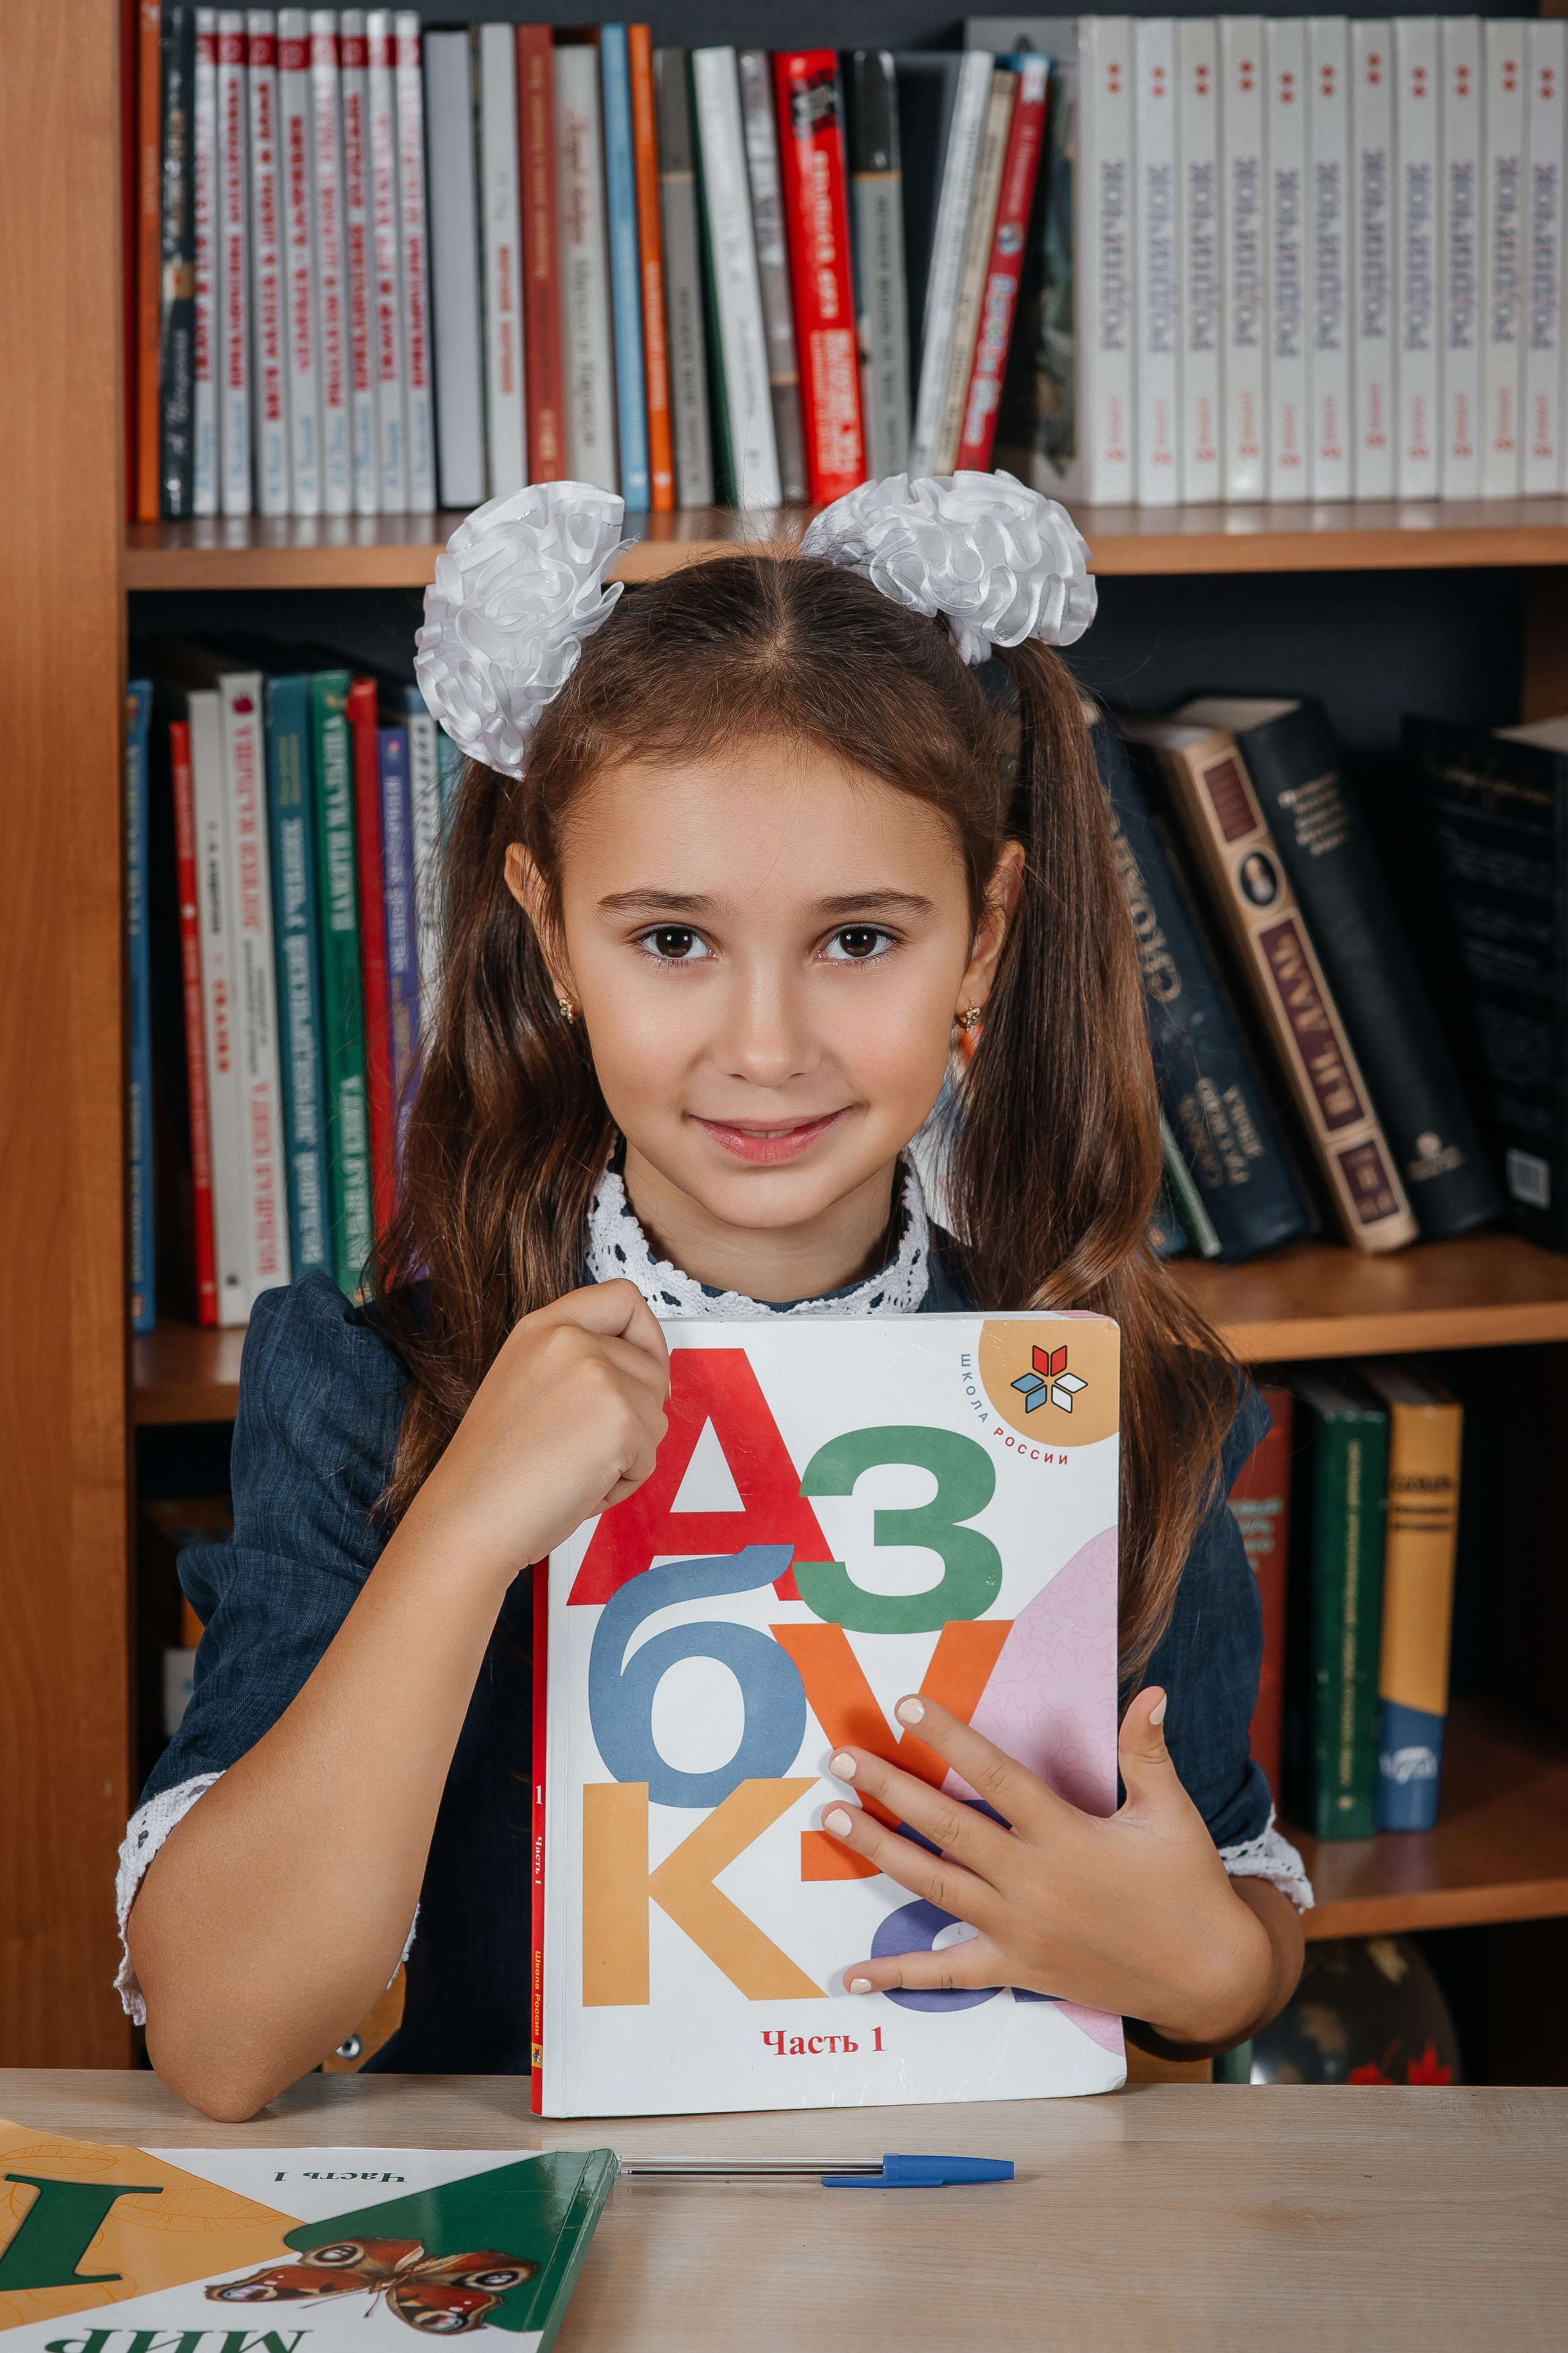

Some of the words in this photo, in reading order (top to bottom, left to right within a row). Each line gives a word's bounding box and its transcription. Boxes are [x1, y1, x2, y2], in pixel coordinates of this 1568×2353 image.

[960, 1353, 989, 1423] ШКОЛА
[993, 1427, 1068, 1465] РОССИИ
[761, 2030, 859, 2056] Часть
[870, 2026, 886, 2052] 1
[303, 2172, 407, 2183] Часть
